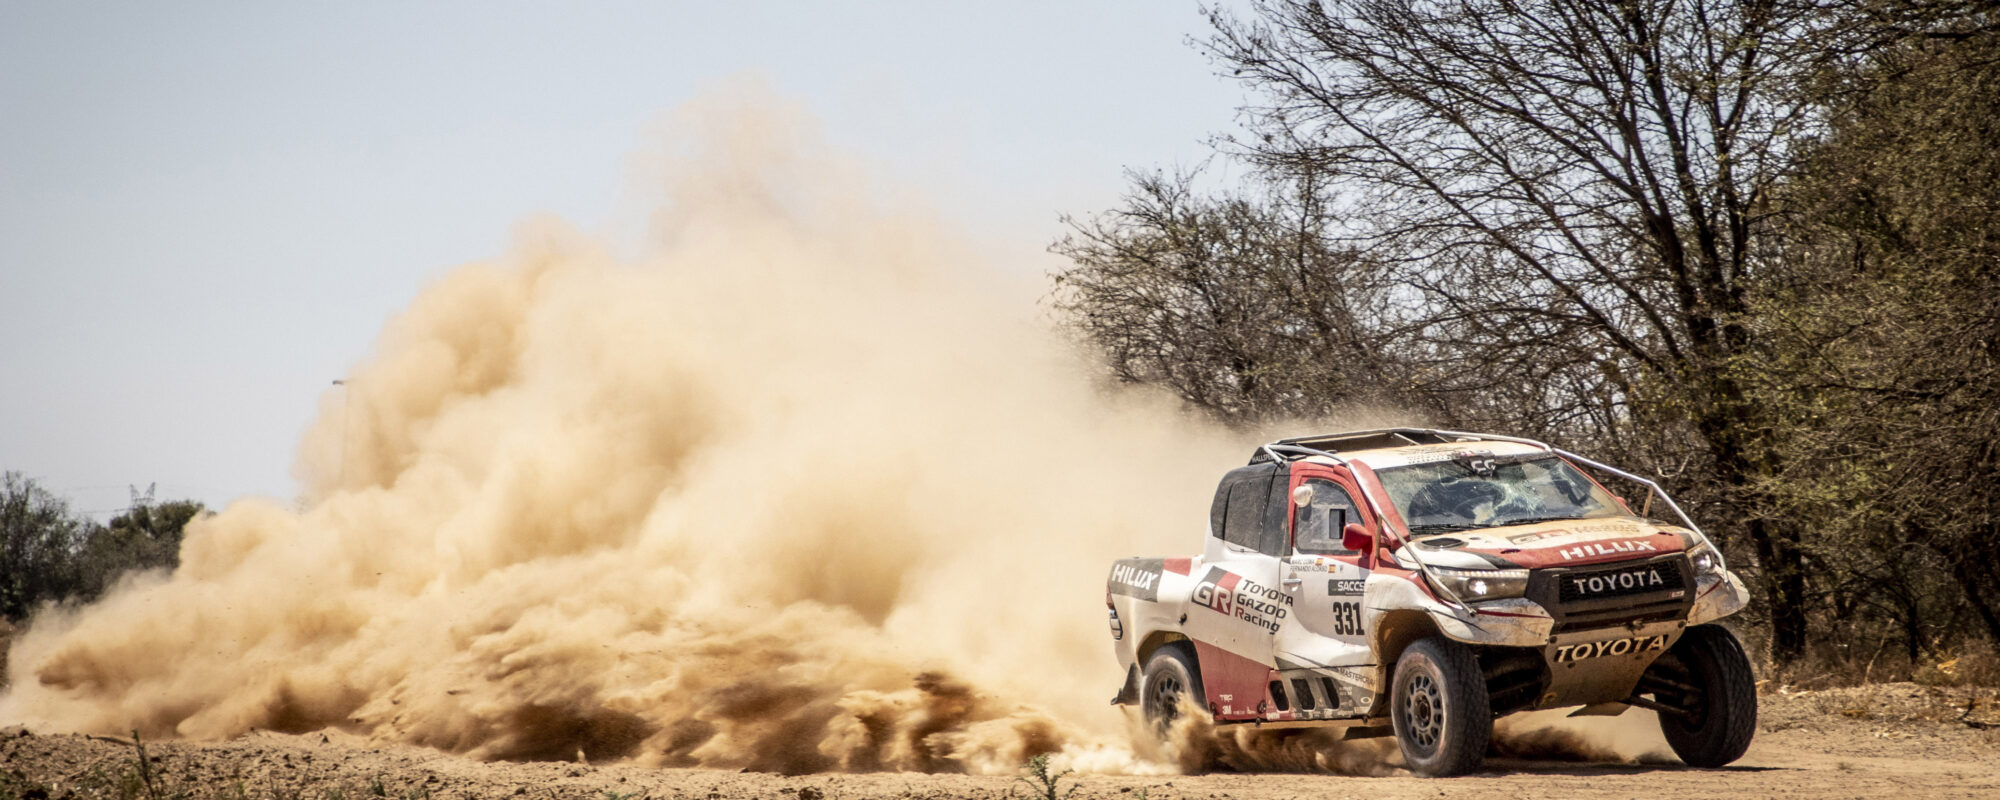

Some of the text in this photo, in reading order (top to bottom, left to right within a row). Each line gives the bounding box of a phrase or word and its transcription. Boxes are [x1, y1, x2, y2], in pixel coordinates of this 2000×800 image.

[1560, 541, 1656, 560] HILUX
[1111, 564, 1160, 591] HILUX
[1573, 570, 1663, 595] TOYOTA
[1192, 581, 1232, 614] GR
[1236, 593, 1287, 619] GAZOO
[1242, 579, 1294, 607] TOYOTA
[1235, 606, 1280, 635] Racing
[1333, 601, 1365, 636] 331
[1557, 635, 1665, 663] TOYOTA
[1222, 705, 1233, 715] 3M
